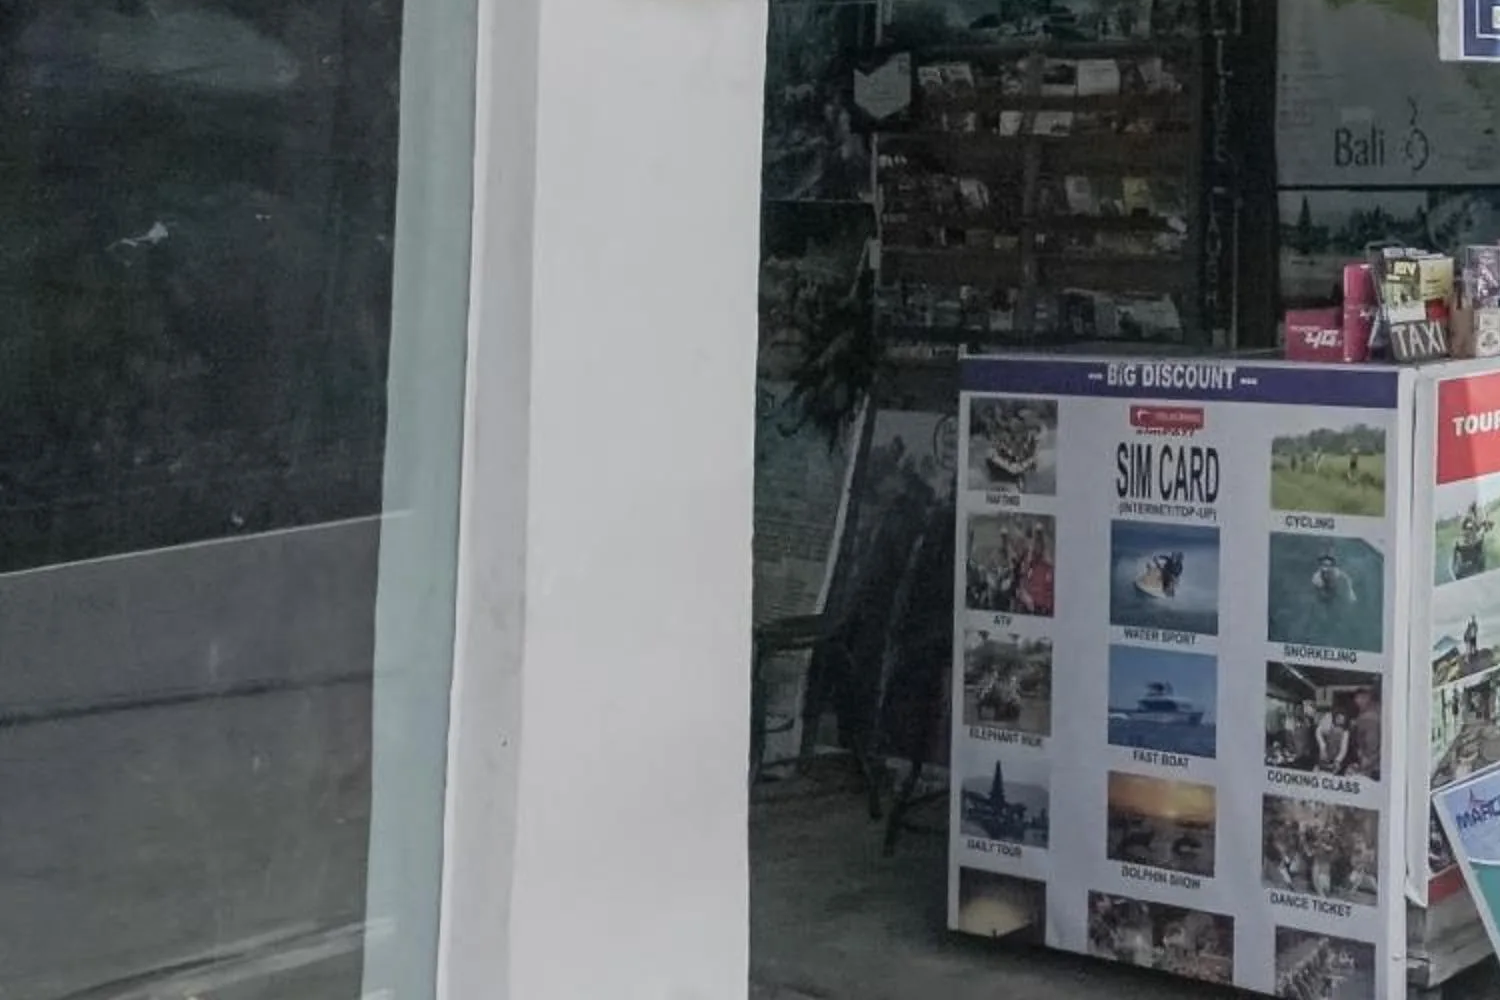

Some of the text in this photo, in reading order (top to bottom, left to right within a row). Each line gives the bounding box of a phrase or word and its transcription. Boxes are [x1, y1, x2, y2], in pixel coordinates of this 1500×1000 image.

[1333, 123, 1385, 168] Bali
[1391, 320, 1447, 358] TAXI
[1142, 364, 1237, 389] DISCOUNT
[1117, 441, 1220, 503] SIM CARD
[1321, 776, 1360, 794] CLASS
